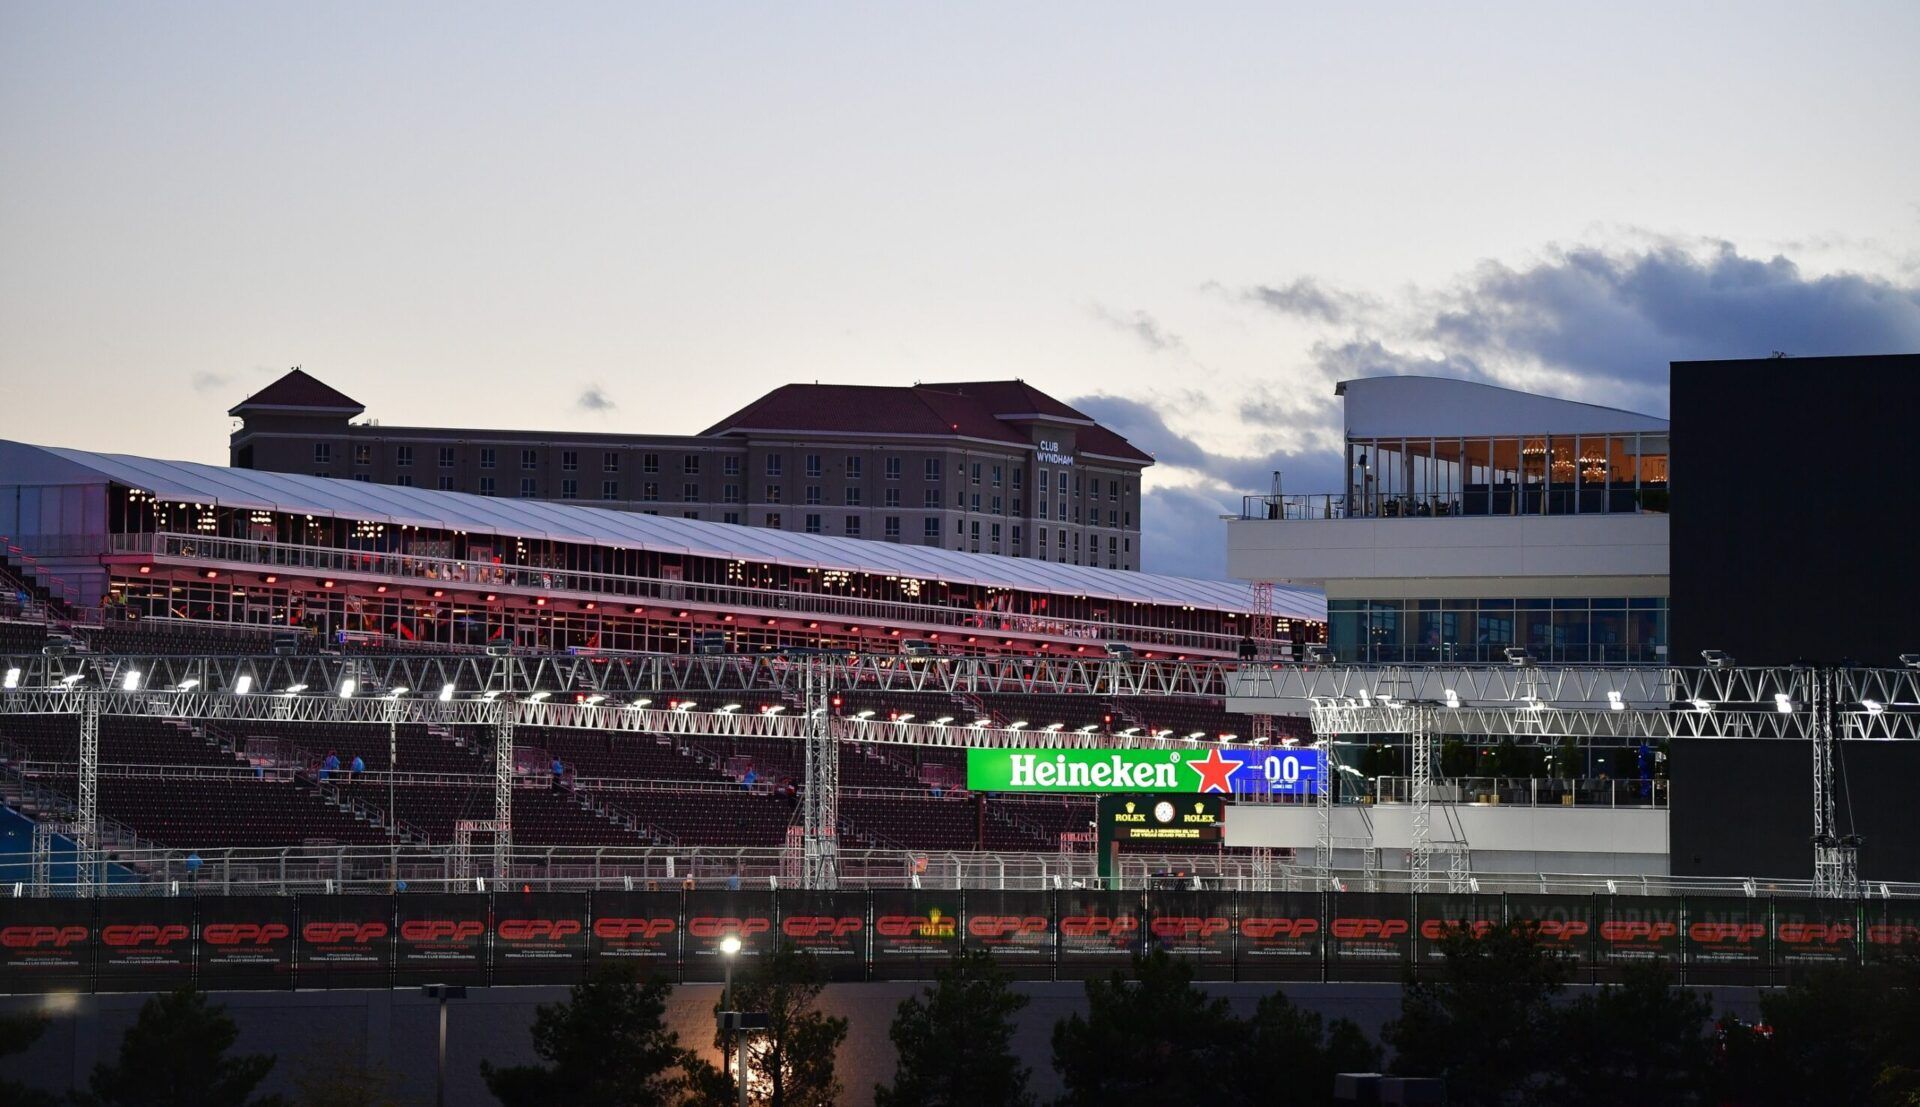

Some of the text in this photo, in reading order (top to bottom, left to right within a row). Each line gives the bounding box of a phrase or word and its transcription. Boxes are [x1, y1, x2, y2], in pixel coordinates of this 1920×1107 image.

[1040, 440, 1059, 452] CLUB
[1036, 451, 1074, 466] WYNDHAM
[1115, 814, 1146, 822] ROLEX
[1183, 815, 1215, 823] ROLEX
[1, 926, 88, 947] GPP
[102, 925, 189, 946] GPP
[203, 923, 289, 944] GPP
[303, 922, 387, 943] GPP
[401, 920, 484, 941] GPP
[498, 919, 581, 940] GPP
[594, 917, 677, 938] GPP
[1240, 917, 1319, 938] GPP
[1333, 918, 1409, 939] GPP
[1600, 921, 1676, 941] GPP
